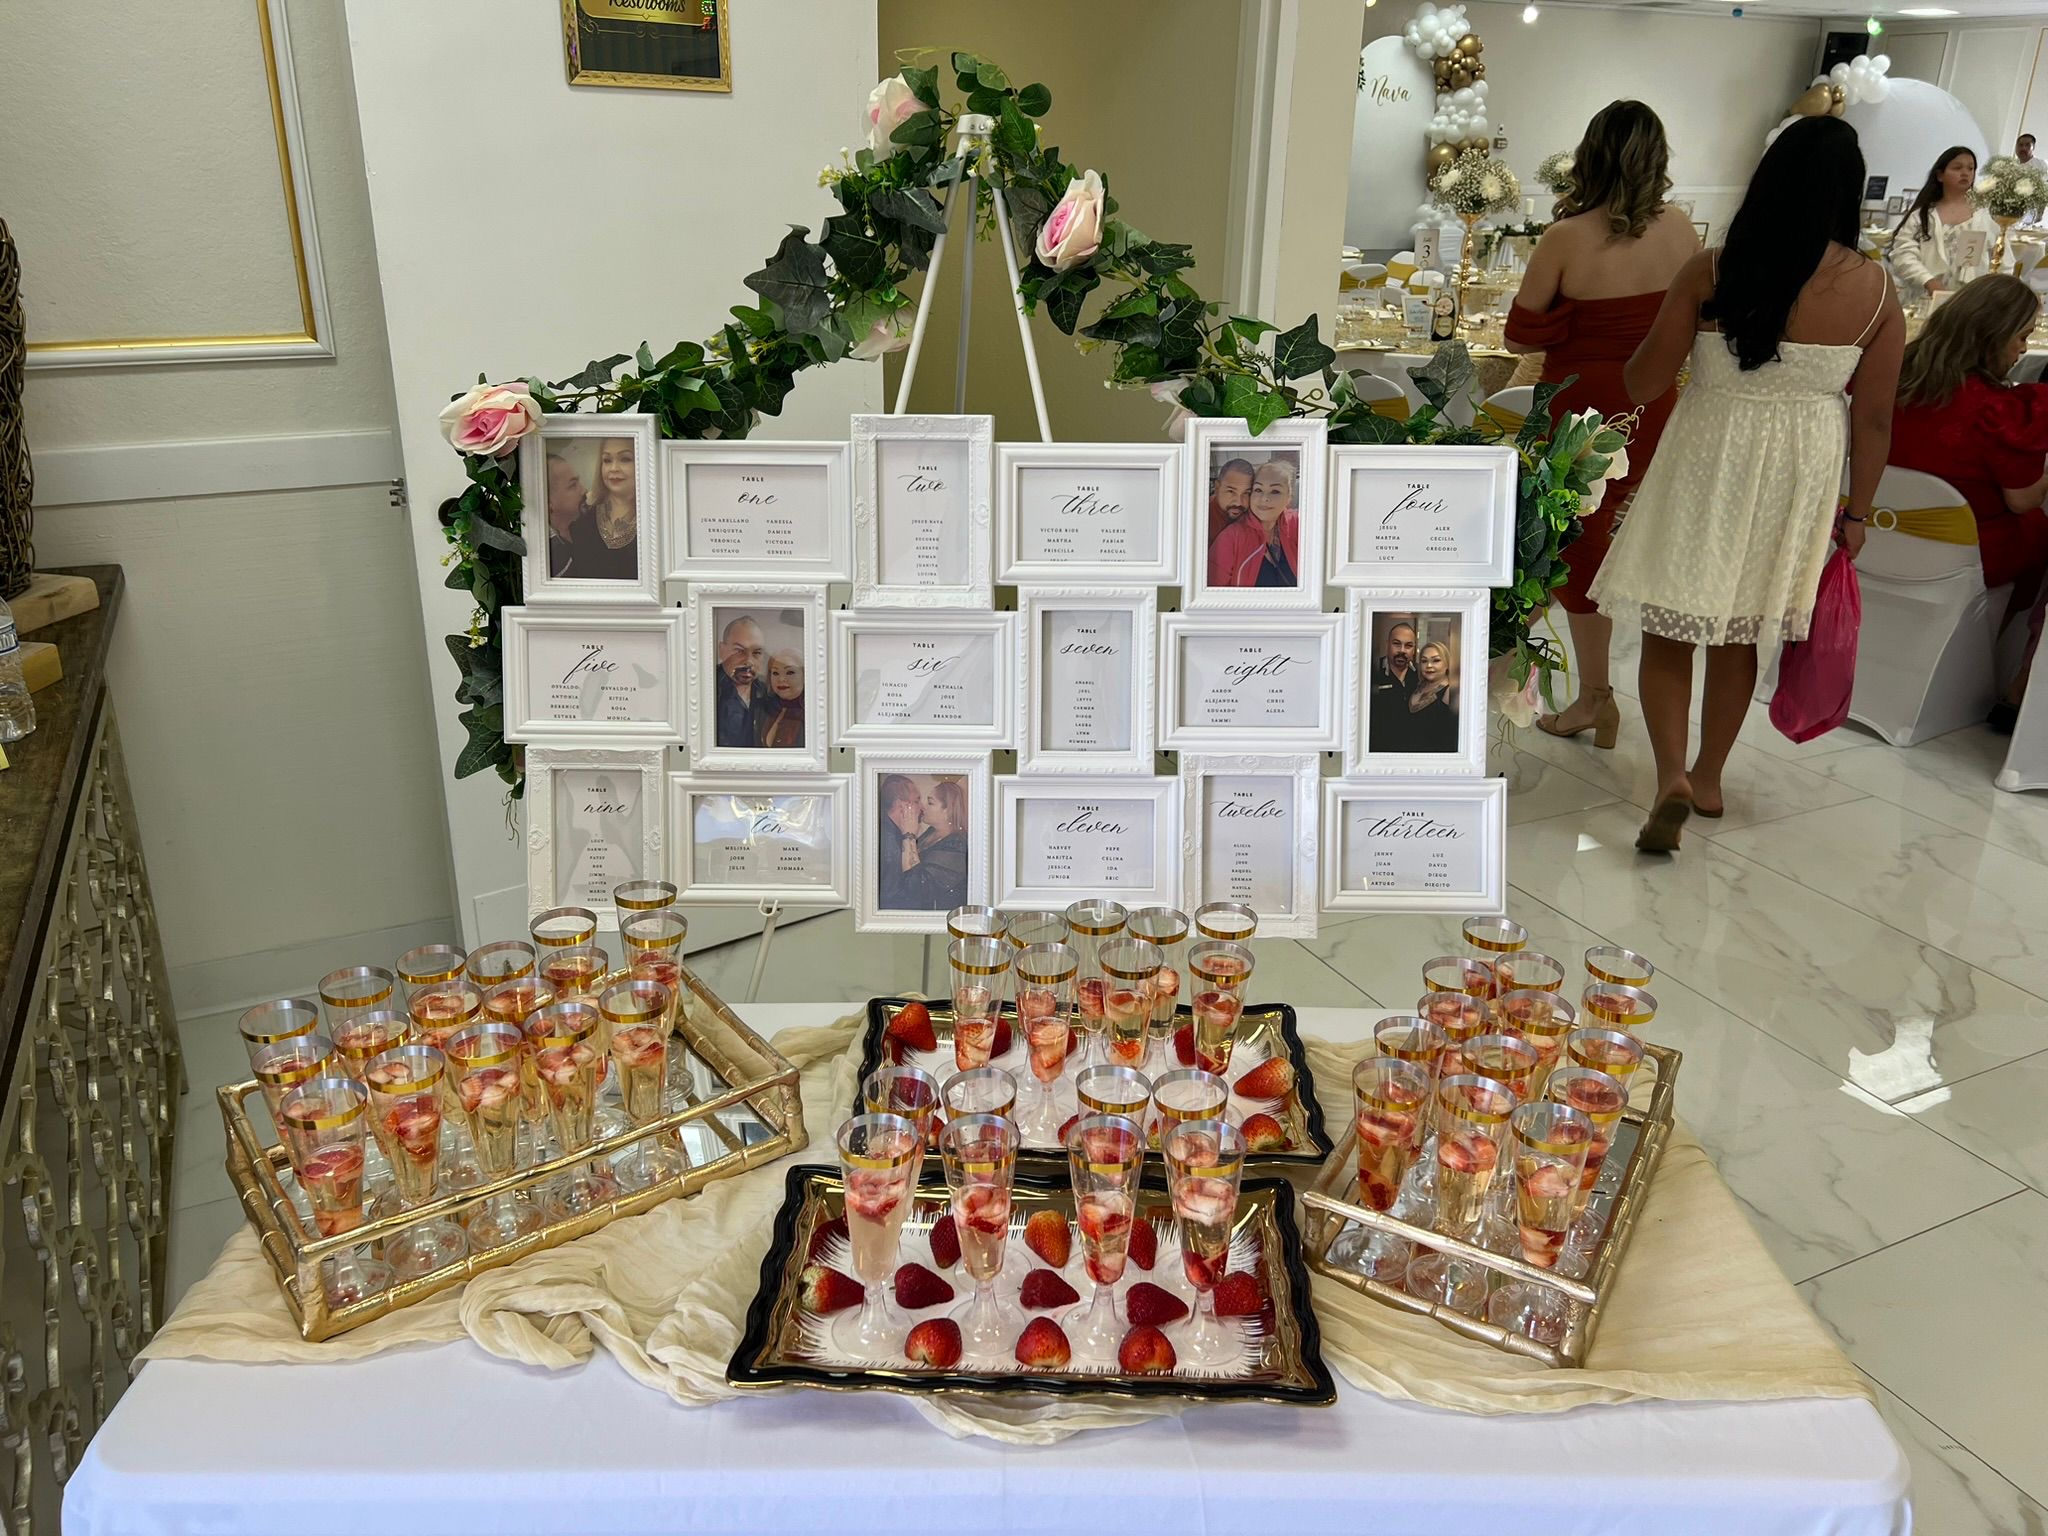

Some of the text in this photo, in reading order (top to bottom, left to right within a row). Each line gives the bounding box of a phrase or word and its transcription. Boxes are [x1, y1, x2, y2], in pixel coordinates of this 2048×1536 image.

[1371, 74, 1412, 107] Nava
[1422, 244, 1431, 259] 3
[1964, 246, 1974, 260] 2
[898, 475, 947, 492] two
[738, 492, 777, 504] one
[1051, 493, 1127, 516] three
[1382, 488, 1448, 524] four
[1060, 644, 1119, 656] seven
[563, 649, 620, 684] five
[907, 656, 960, 677] six
[1224, 654, 1312, 685] eight
[584, 801, 628, 813] nine
[1210, 800, 1286, 818] twelve
[751, 815, 788, 834] ten
[1057, 812, 1128, 834] eleven
[1357, 817, 1464, 839] thirteen
